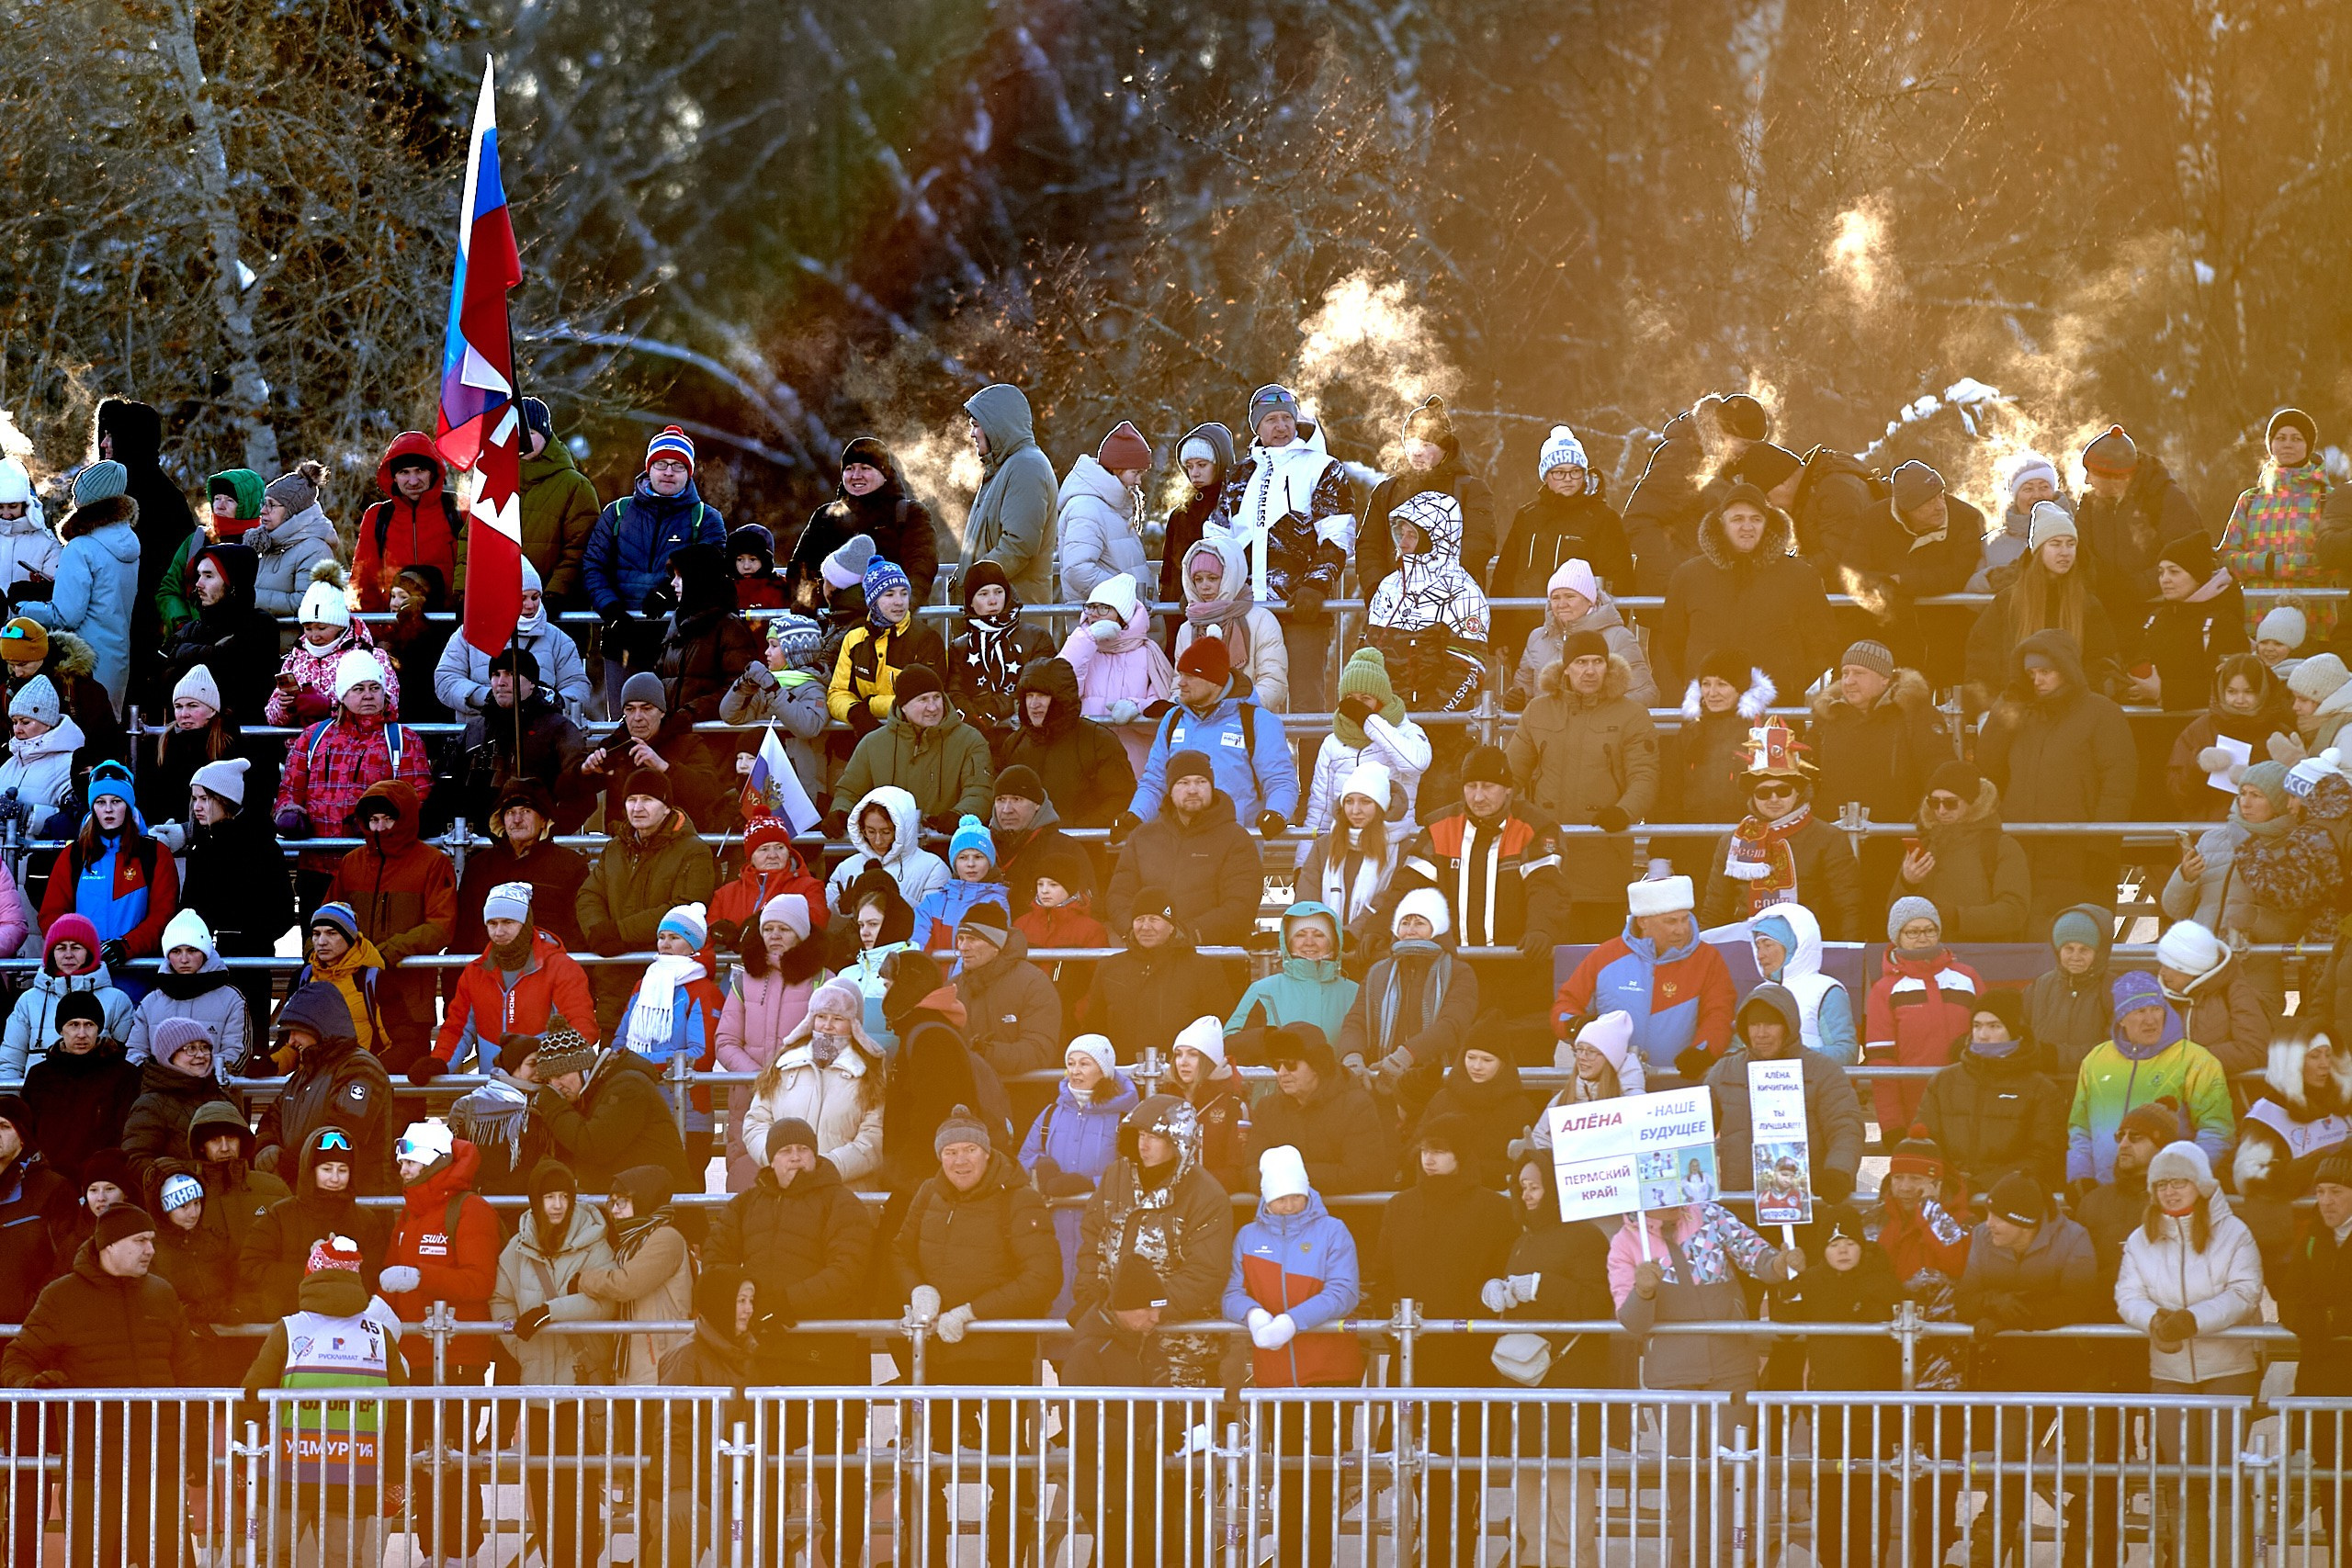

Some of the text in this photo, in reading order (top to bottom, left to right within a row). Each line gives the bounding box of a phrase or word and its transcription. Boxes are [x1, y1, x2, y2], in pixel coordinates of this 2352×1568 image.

[1256, 479, 1271, 527] FEARLESS
[869, 577, 899, 600] RUSSIA
[1764, 1070, 1791, 1078] АЛЁНА
[1561, 1112, 1623, 1133] АЛЁНА
[1655, 1100, 1696, 1117] НАШЕ
[1640, 1121, 1706, 1141] БУДУЩЕЕ
[1565, 1165, 1631, 1185] ПЕРМСКИЙ
[1582, 1185, 1618, 1201] КРАЙ!
[360, 1319, 380, 1335] 45
[285, 1438, 373, 1458] УДМУРИЯ
